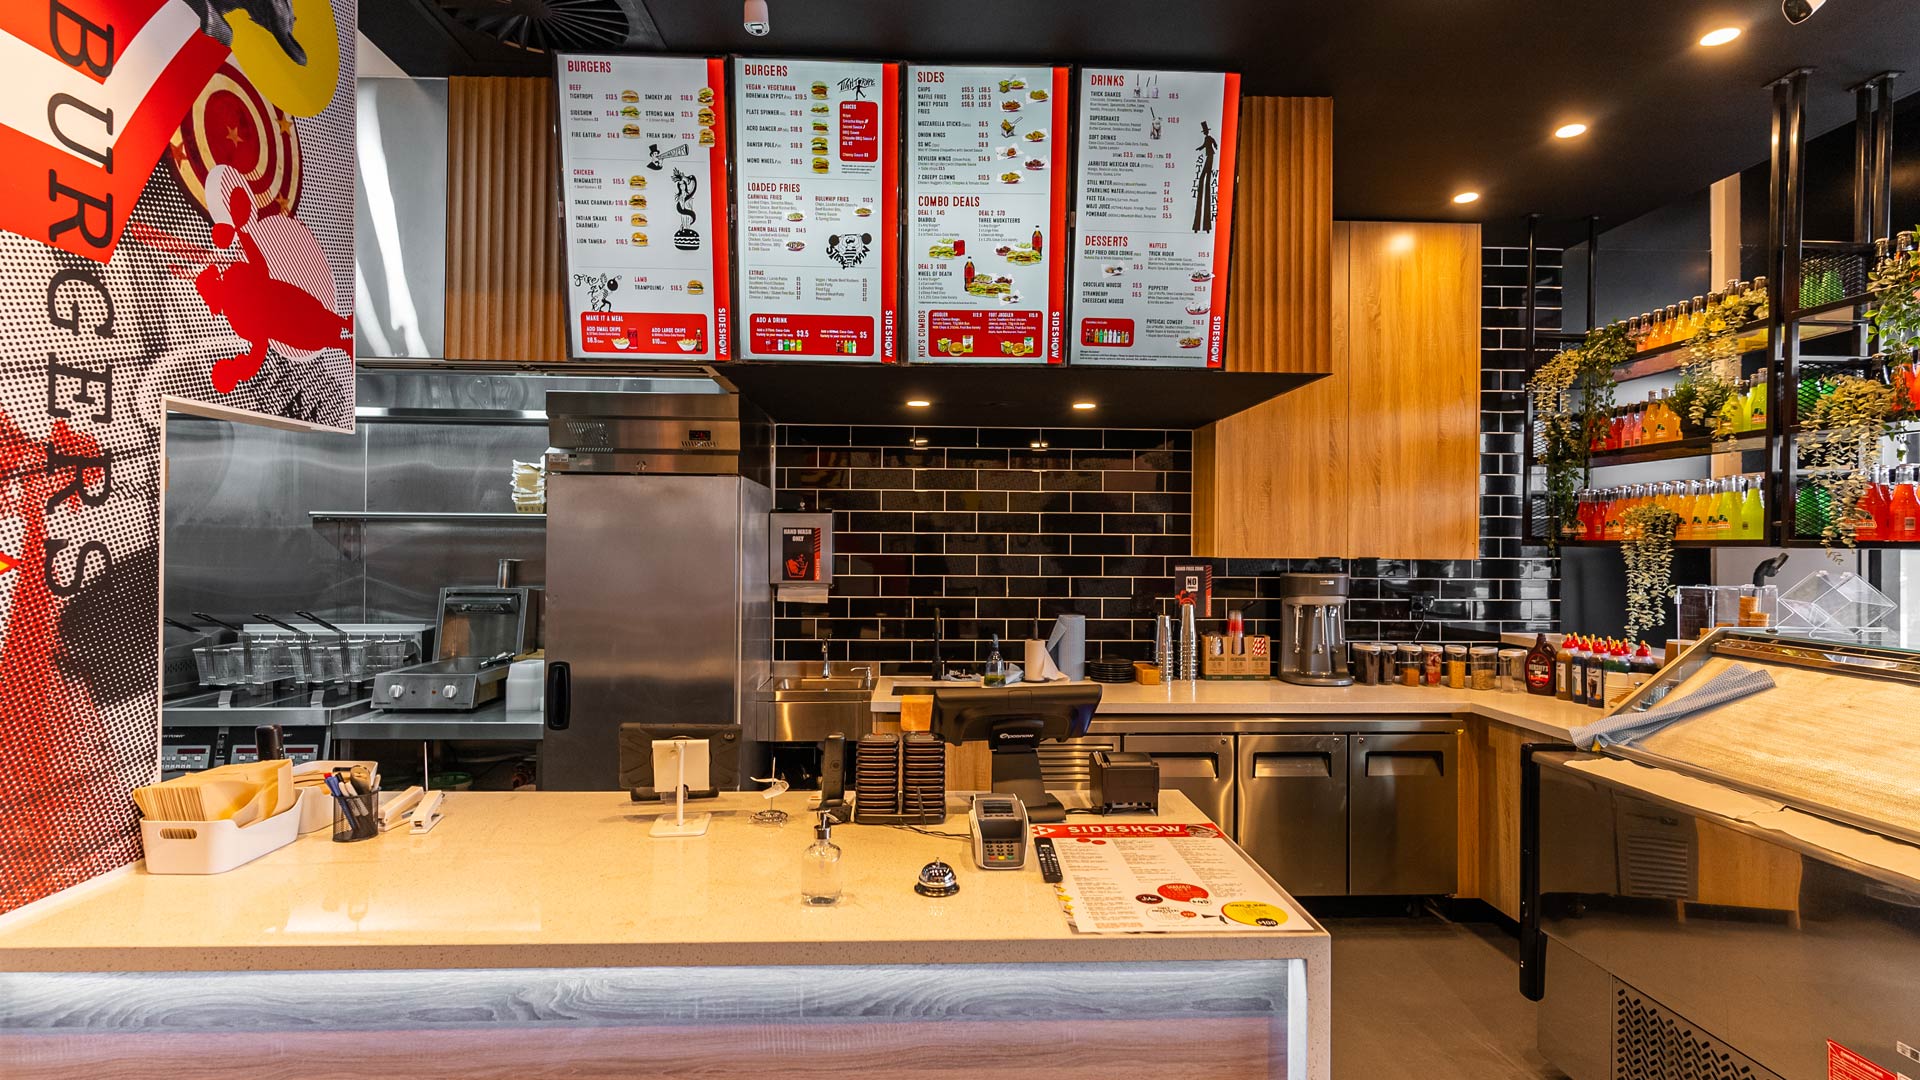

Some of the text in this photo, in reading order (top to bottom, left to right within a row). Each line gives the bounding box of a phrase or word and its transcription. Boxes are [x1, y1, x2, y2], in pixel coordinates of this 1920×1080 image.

[568, 60, 611, 73] BURGERS
[745, 64, 787, 76] BURGERS
[918, 72, 944, 83] SIDES
[1091, 75, 1124, 86] DRINKS
[748, 182, 800, 192] LOADED FRIES
[918, 196, 980, 207] COMBO DEALS
[1086, 236, 1128, 247] DESSERTS
[47, 0, 116, 597] BURGERS
[718, 308, 726, 355] SIDESHOW
[1211, 316, 1221, 362] SIDESHOW
